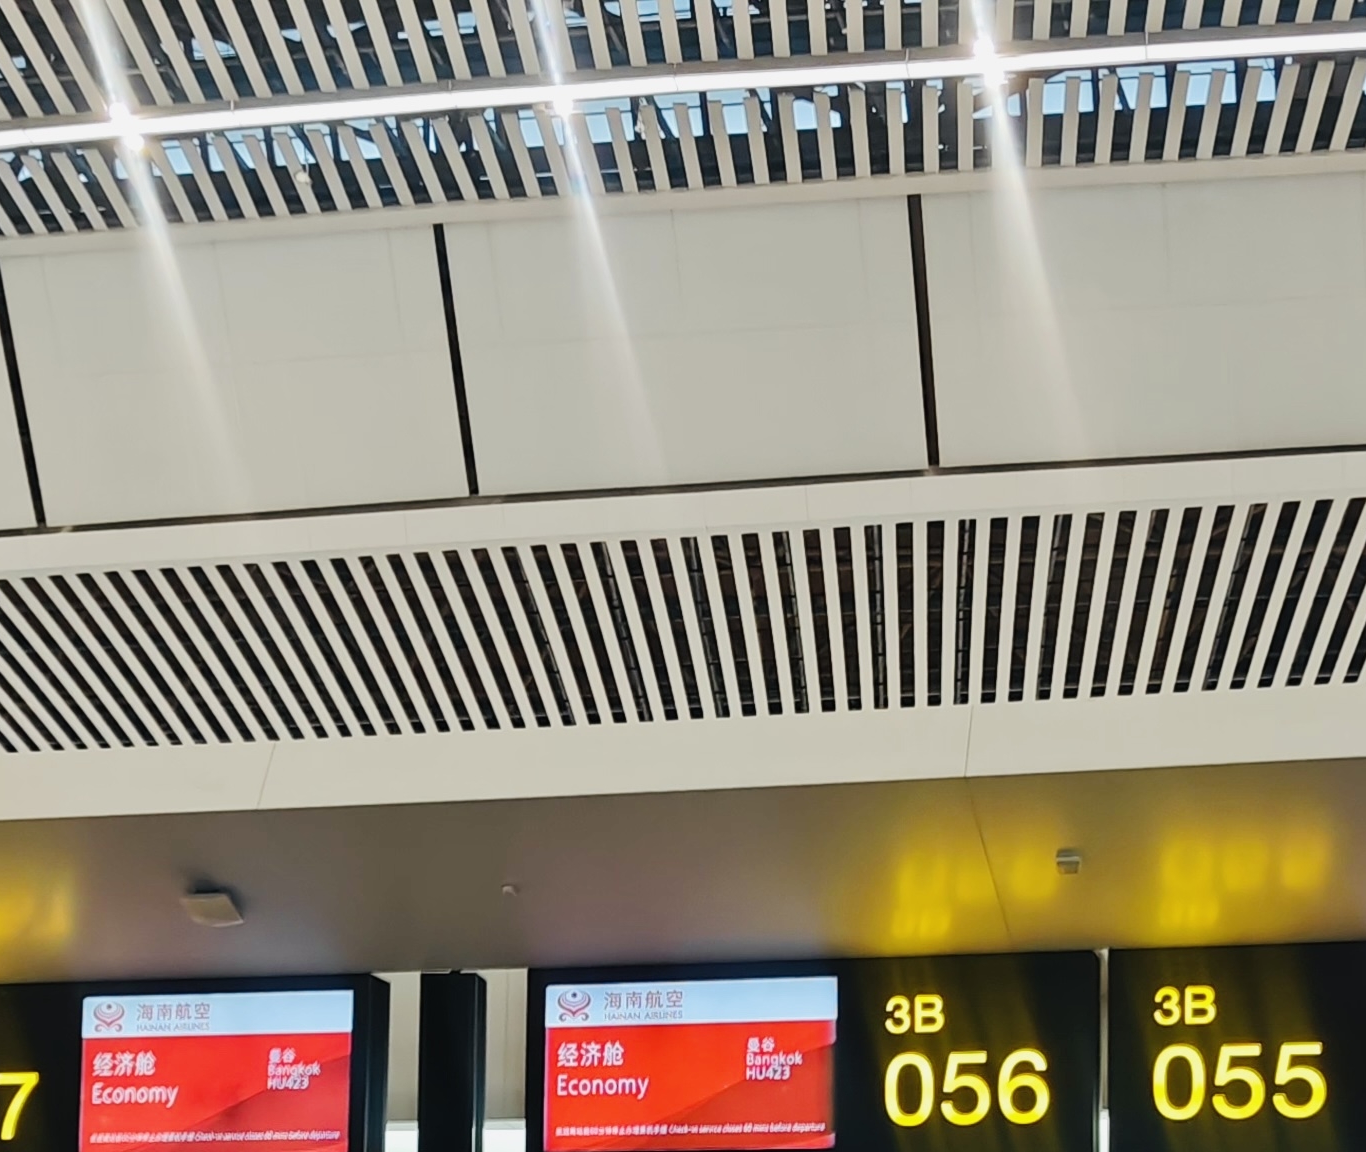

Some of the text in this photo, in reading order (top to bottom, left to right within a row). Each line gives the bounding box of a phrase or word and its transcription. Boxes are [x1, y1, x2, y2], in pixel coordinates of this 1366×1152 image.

[605, 990, 683, 1010] 海南航空
[1153, 985, 1216, 1025] 3B
[137, 1003, 210, 1021] 海南航空
[605, 1011, 641, 1021] HAINAN
[885, 994, 944, 1034] 3B
[137, 1023, 171, 1032] HAINAN
[92, 1051, 156, 1077] 经济舱
[557, 1040, 624, 1067] 经济舱
[746, 1051, 803, 1067] Bangkok
[267, 1061, 321, 1077] Bangkok
[746, 1067, 790, 1080] HU423
[267, 1077, 309, 1090] HU423
[557, 1075, 649, 1099] Economy
[885, 1049, 1049, 1127] 056
[1152, 1042, 1327, 1120] 055
[92, 1082, 179, 1108] Economy
